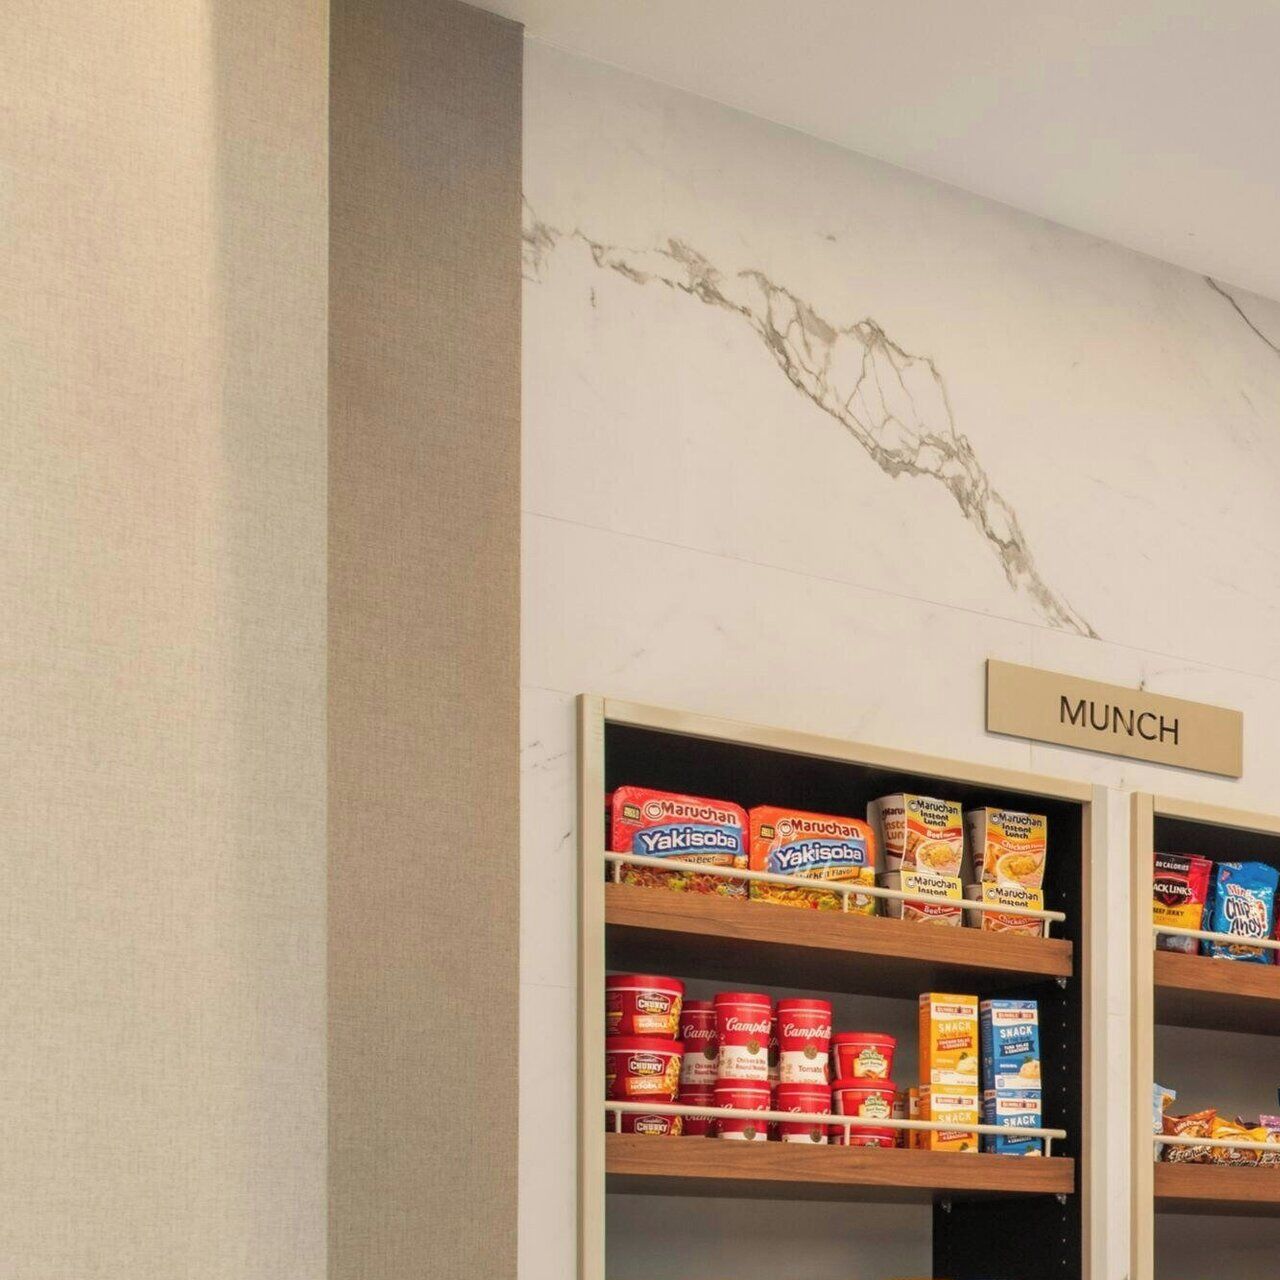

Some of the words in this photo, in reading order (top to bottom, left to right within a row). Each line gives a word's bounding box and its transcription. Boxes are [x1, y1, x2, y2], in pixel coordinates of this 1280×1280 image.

[1060, 695, 1179, 745] MUNCH
[661, 801, 737, 824] Maruchan
[917, 800, 959, 815] Maruchan
[920, 810, 949, 821] Instant
[999, 812, 1043, 827] Maruchan
[791, 819, 860, 838] Maruchan
[923, 818, 947, 828] Lunch
[1002, 823, 1032, 833] Instant
[641, 827, 738, 851] Yakisoba
[1005, 830, 1029, 839] Lunch
[1001, 841, 1031, 851] Chicken
[776, 843, 862, 869] Yakisoba
[1163, 862, 1190, 871] CALORIES
[914, 876, 958, 891] Maruchan
[1153, 882, 1168, 893] ACK
[918, 886, 948, 897] Instant
[995, 887, 1039, 901] Maruchan
[938, 1021, 972, 1032] SNACK
[1000, 1026, 1033, 1039] SNACK
[798, 1065, 822, 1073] Tomato
[938, 1113, 972, 1123] SNACK
[1003, 1115, 1036, 1127] SNACK
